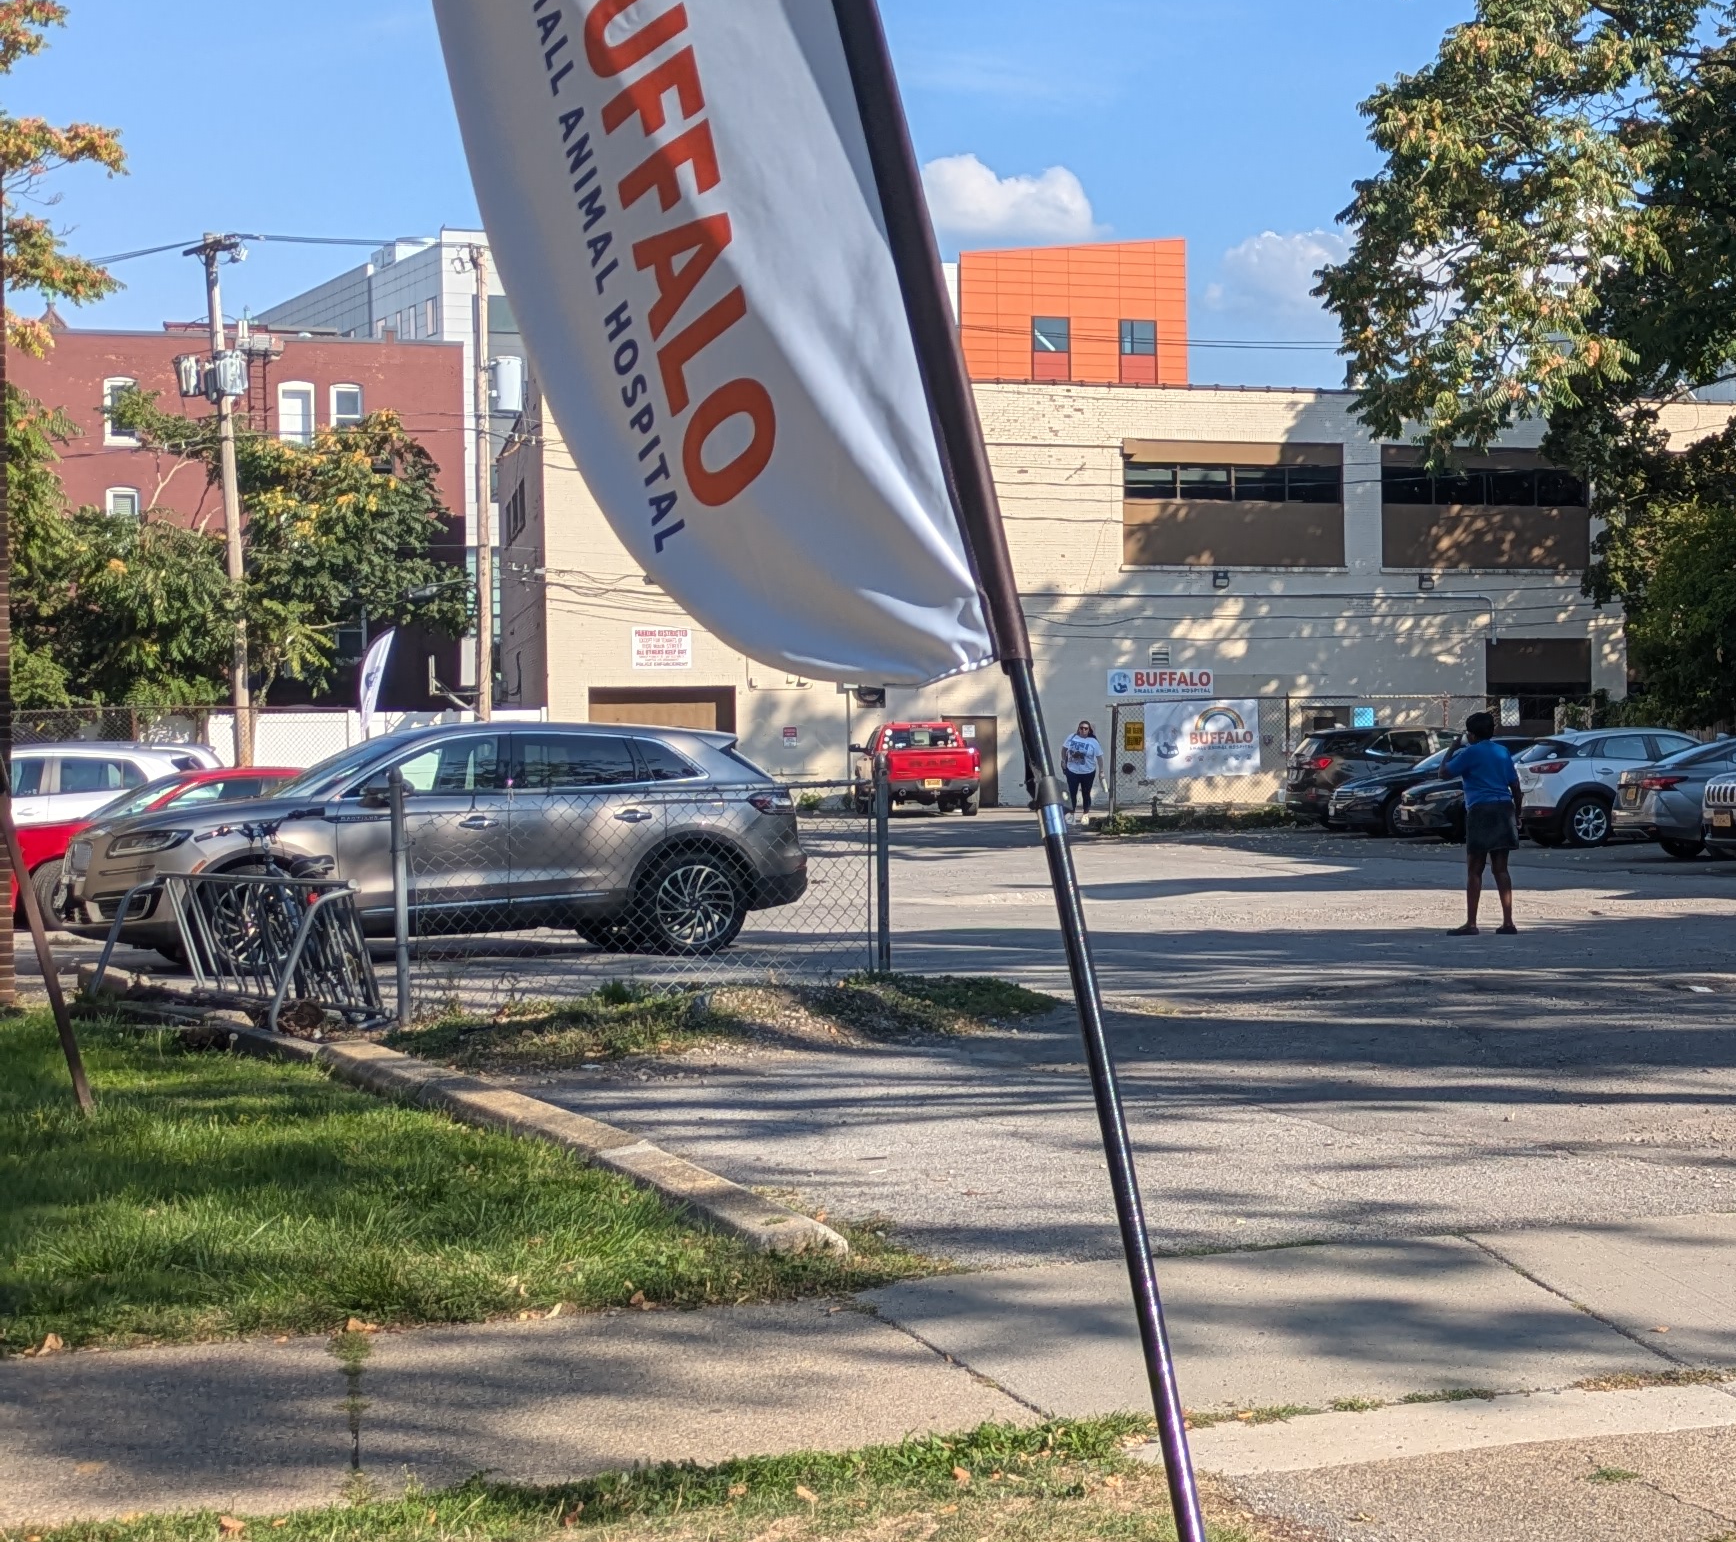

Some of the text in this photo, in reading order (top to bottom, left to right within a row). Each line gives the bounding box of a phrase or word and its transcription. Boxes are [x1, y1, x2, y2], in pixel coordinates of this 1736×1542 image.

[559, 106, 619, 295] ANIMAL
[603, 299, 686, 554] HOSPITAL
[1134, 671, 1211, 687] BUFFALO
[1189, 731, 1254, 745] BUFFALO
